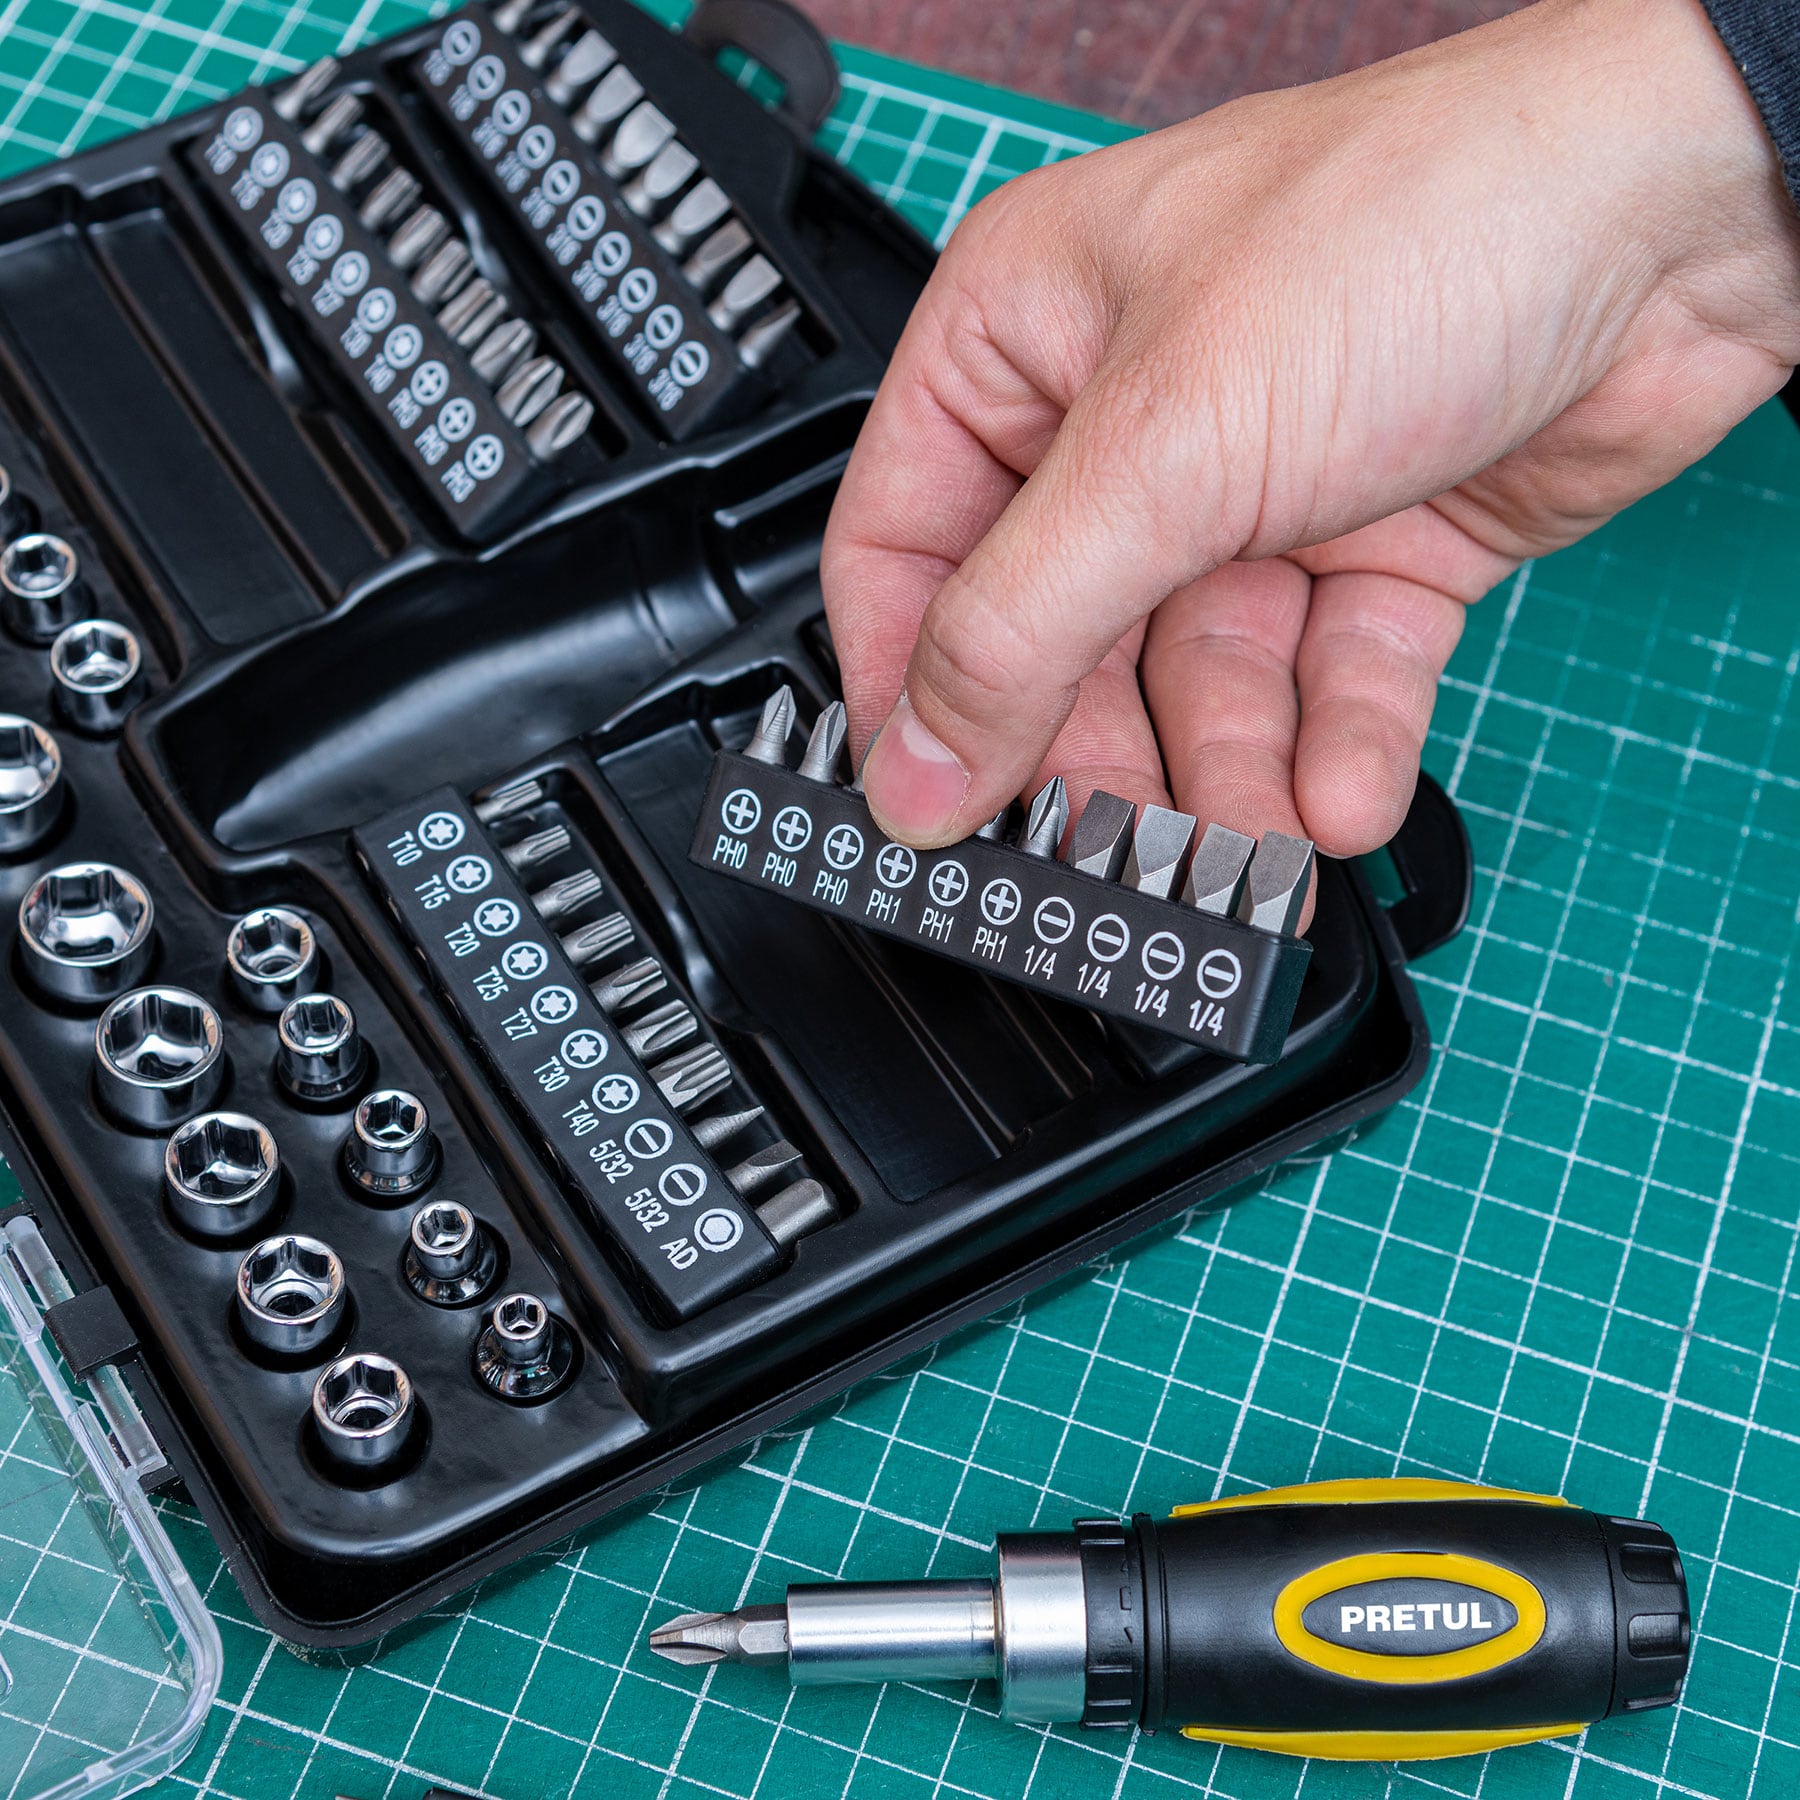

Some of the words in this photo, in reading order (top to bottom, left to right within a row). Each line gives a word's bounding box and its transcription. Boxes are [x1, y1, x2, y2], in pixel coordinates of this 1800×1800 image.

[712, 833, 748, 870] PH0
[761, 851, 797, 888] PH0
[812, 869, 849, 906] PH0
[865, 888, 902, 925] PH1
[918, 906, 955, 944] PH1
[971, 925, 1008, 963] PH1
[1023, 944, 1058, 981] 1/4
[1077, 962, 1112, 999] 1/4
[1134, 981, 1170, 1019] 1/4
[1188, 999, 1226, 1037] 1/4
[386, 830, 424, 867] T10
[414, 873, 452, 910] T15
[443, 921, 481, 958] T20
[472, 965, 510, 1002] T25
[500, 1006, 539, 1042] T27
[532, 1055, 571, 1093] T30
[561, 1098, 600, 1137] T40
[589, 1138, 635, 1185] 5/32
[624, 1187, 670, 1234] 5/32
[658, 1237, 699, 1271] AD
[1340, 1602, 1492, 1633] PRETUL
